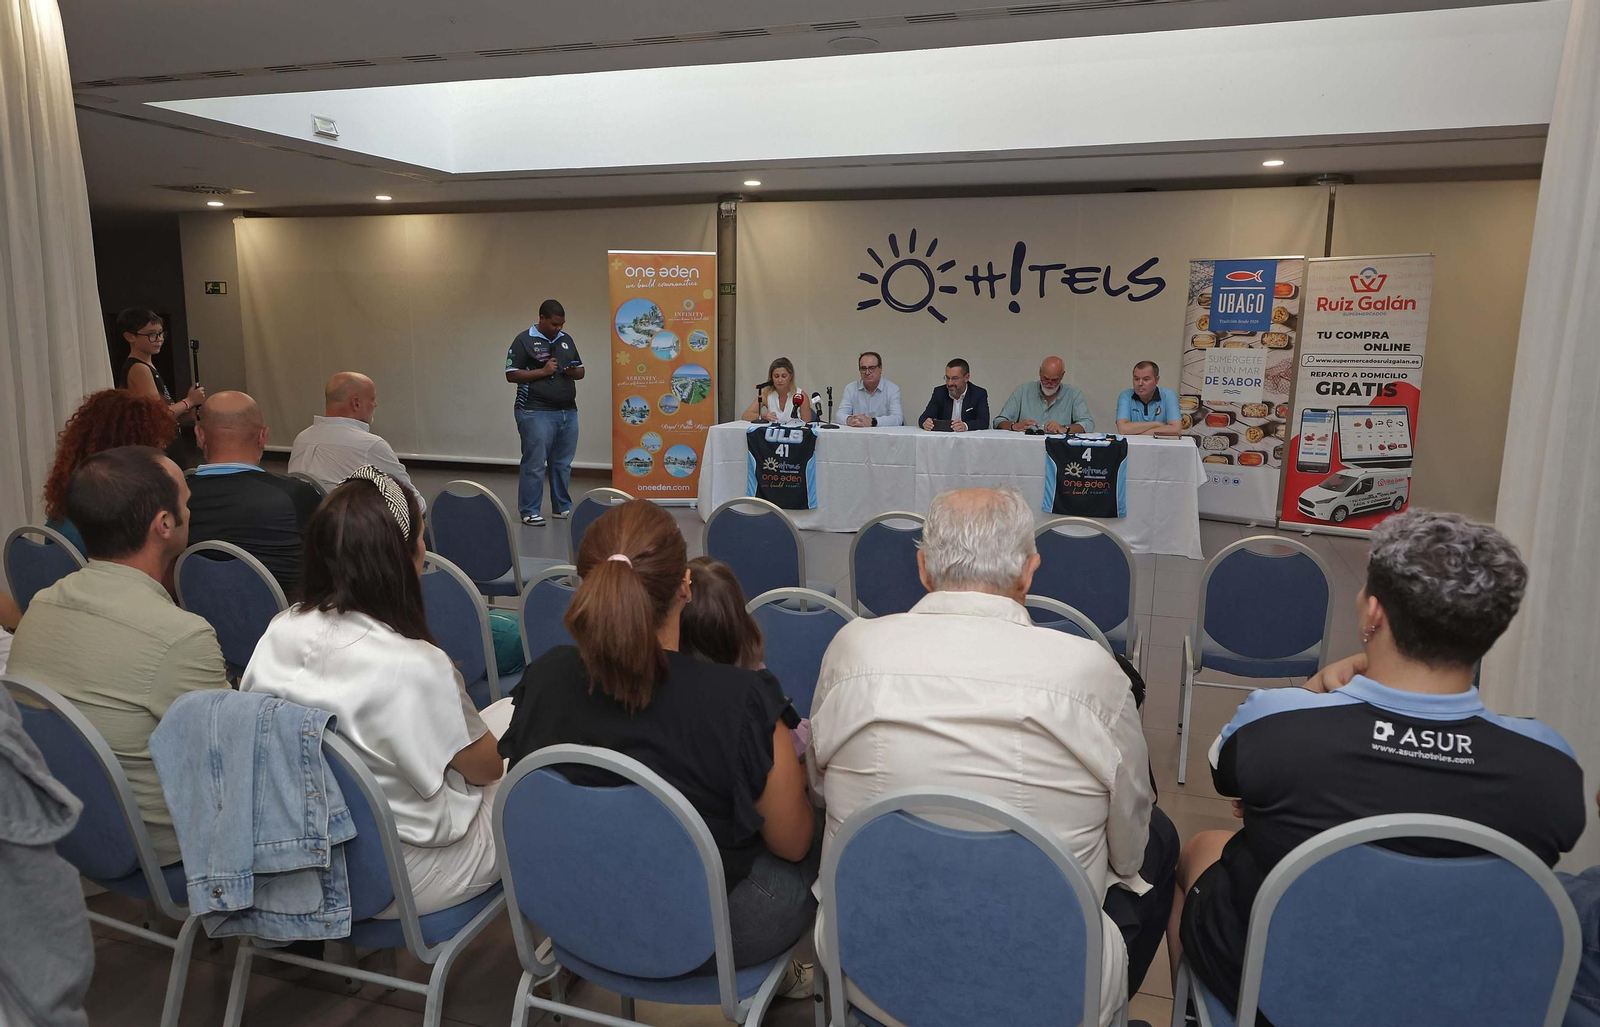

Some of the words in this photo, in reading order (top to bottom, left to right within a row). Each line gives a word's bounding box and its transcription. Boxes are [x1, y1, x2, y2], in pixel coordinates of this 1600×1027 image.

[625, 266, 656, 278] one
[659, 265, 700, 278] eden
[637, 279, 656, 288] build
[658, 279, 698, 288] communities
[1218, 293, 1265, 314] UBAGO
[1316, 297, 1354, 312] Ruiz
[1358, 294, 1417, 310] Galán
[1317, 331, 1332, 340] TU
[1336, 331, 1390, 340] COMPRA
[1364, 343, 1411, 352] ONLINE
[1208, 354, 1263, 364] SUMÉRGETE
[1208, 365, 1220, 374] EN
[1222, 366, 1237, 374] UN
[1238, 366, 1260, 375] MAR
[1205, 376, 1219, 385] DE
[1222, 376, 1262, 387] SABOR
[1316, 381, 1398, 398] GRATIS
[775, 444, 790, 458] 41
[1082, 447, 1092, 462] 4
[1399, 727, 1472, 754] ASUR
[1372, 744, 1475, 764] www.asurhoteles.com
